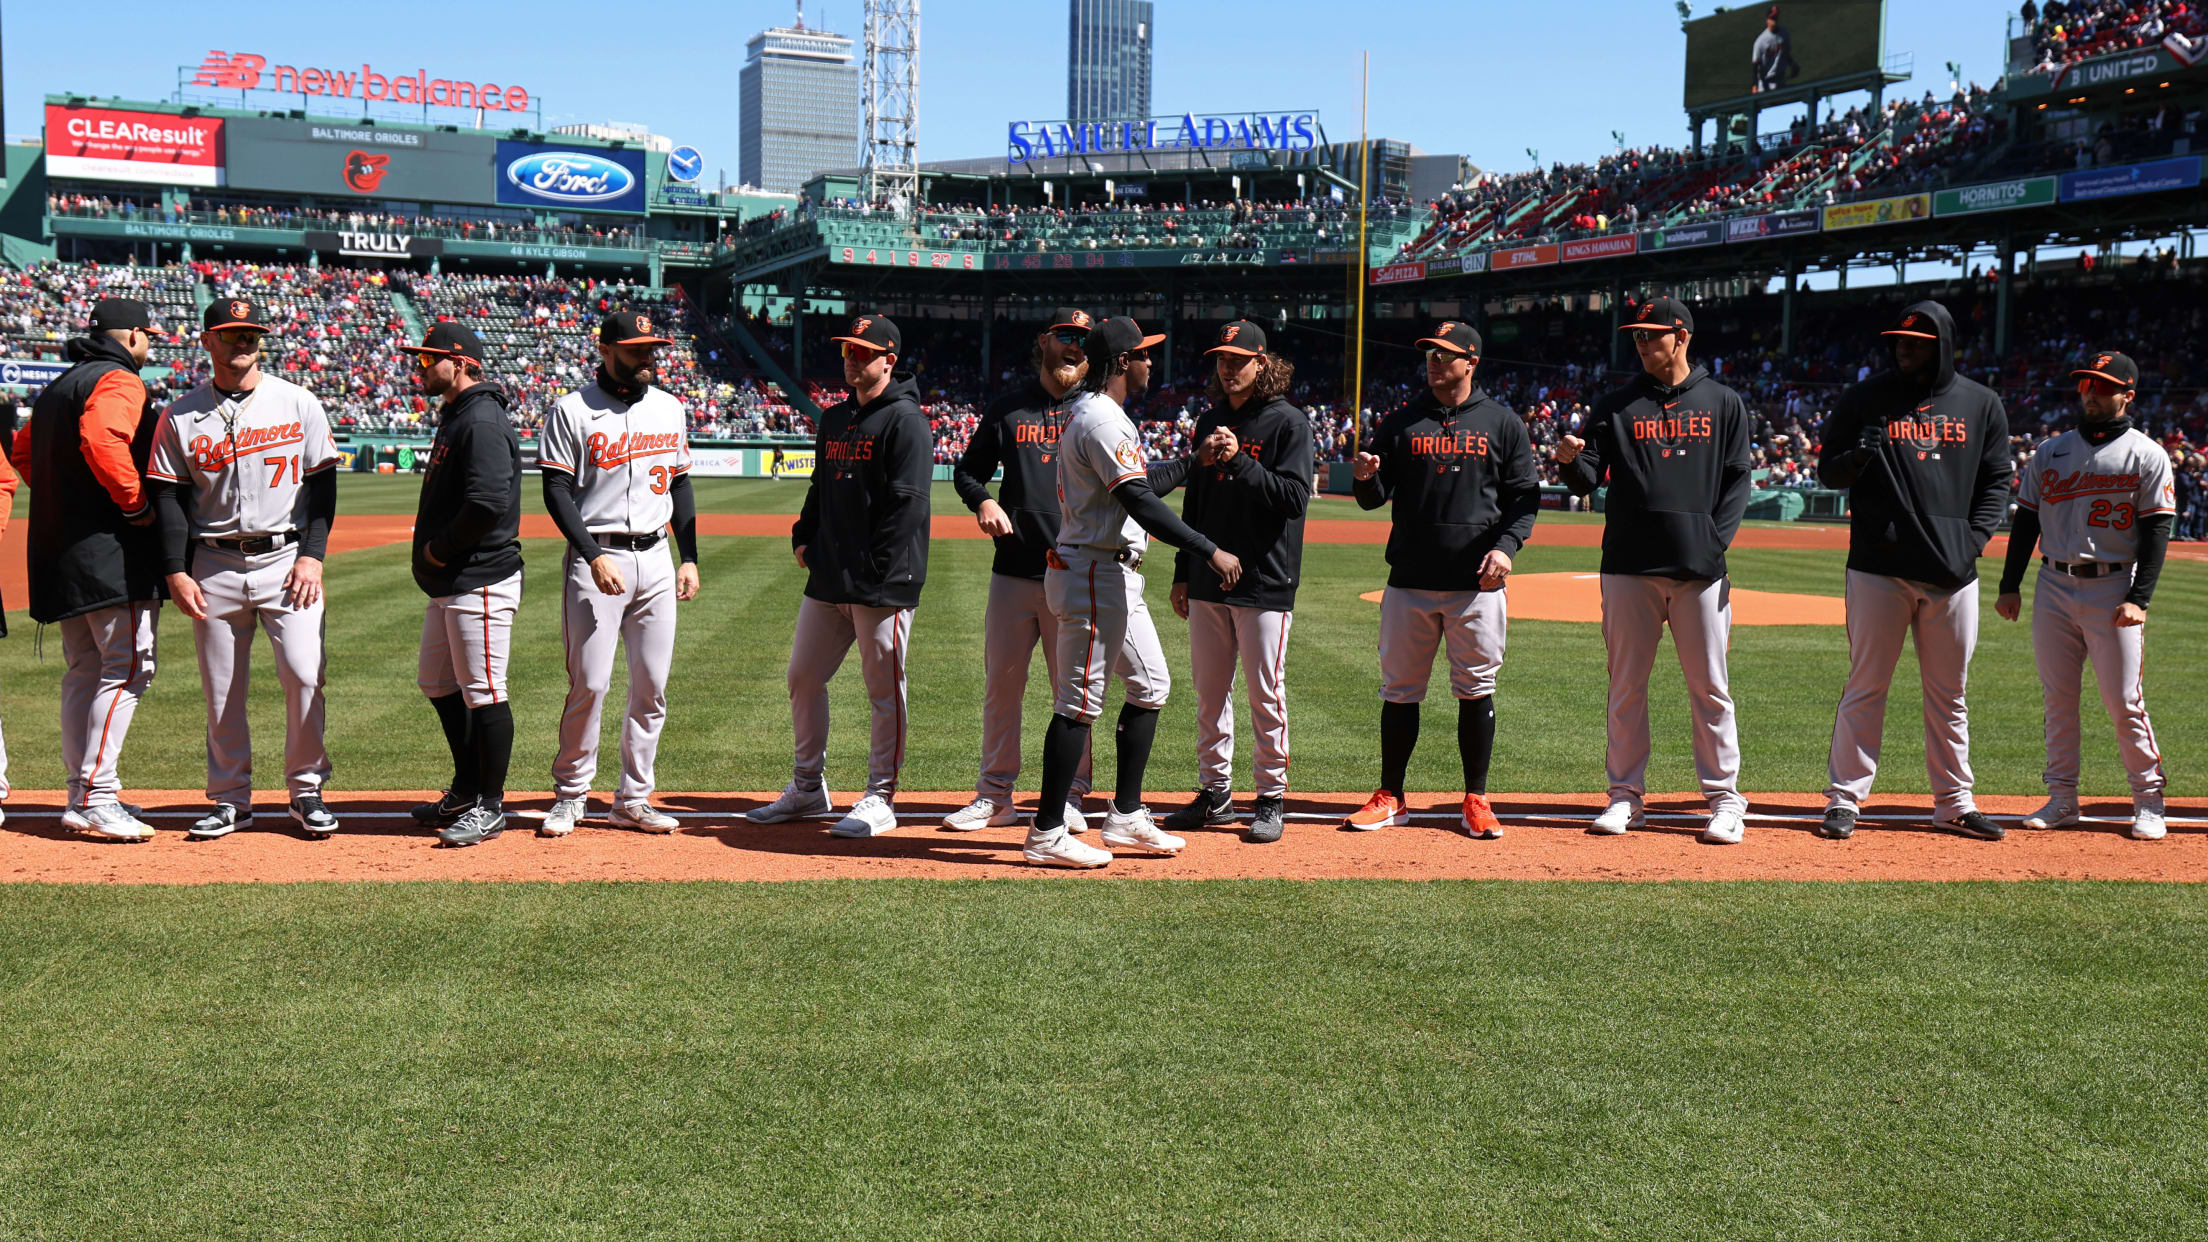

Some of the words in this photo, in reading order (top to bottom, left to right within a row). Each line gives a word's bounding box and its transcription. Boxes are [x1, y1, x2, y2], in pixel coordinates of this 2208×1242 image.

[2089, 55, 2158, 81] UNITED
[67, 118, 204, 146] CLEAResult
[312, 127, 372, 141] BALTIMORE
[374, 132, 419, 144] ORIOLES
[1008, 120, 1166, 164] SAMUEL
[1175, 111, 1317, 153] ADAMS
[534, 158, 610, 194] Ford
[1960, 182, 2026, 205] HORNITOS
[125, 224, 186, 237] BALTIMORE
[190, 228, 235, 240] ORIOLES
[338, 231, 410, 252] TRULY
[525, 247, 549, 256] KYLE
[552, 248, 587, 259] GIBSON
[1592, 239, 1632, 254] HAWAIIAN
[842, 248, 854, 263] 9
[866, 250, 877, 264] 4
[889, 251, 896, 264] 1
[908, 252, 919, 266] 8
[931, 253, 951, 267] 27
[963, 254, 974, 269] 6
[995, 255, 1009, 269] 14
[1022, 254, 1041, 269] 45
[1463, 254, 1485, 271] GIN
[1511, 251, 1538, 264] STIHL
[1395, 266, 1419, 279] PIZZA
[22, 370, 48, 380] NESN
[1633, 417, 1711, 440] ORIOLES
[1888, 421, 1966, 442] ORIOLES
[190, 421, 303, 470] Baltimore
[587, 432, 679, 467] Baltimore
[1411, 436, 1488, 456] ORIOLES
[264, 455, 299, 488] 71
[2041, 469, 2139, 497] Baltimore
[2087, 499, 2135, 530] 23
